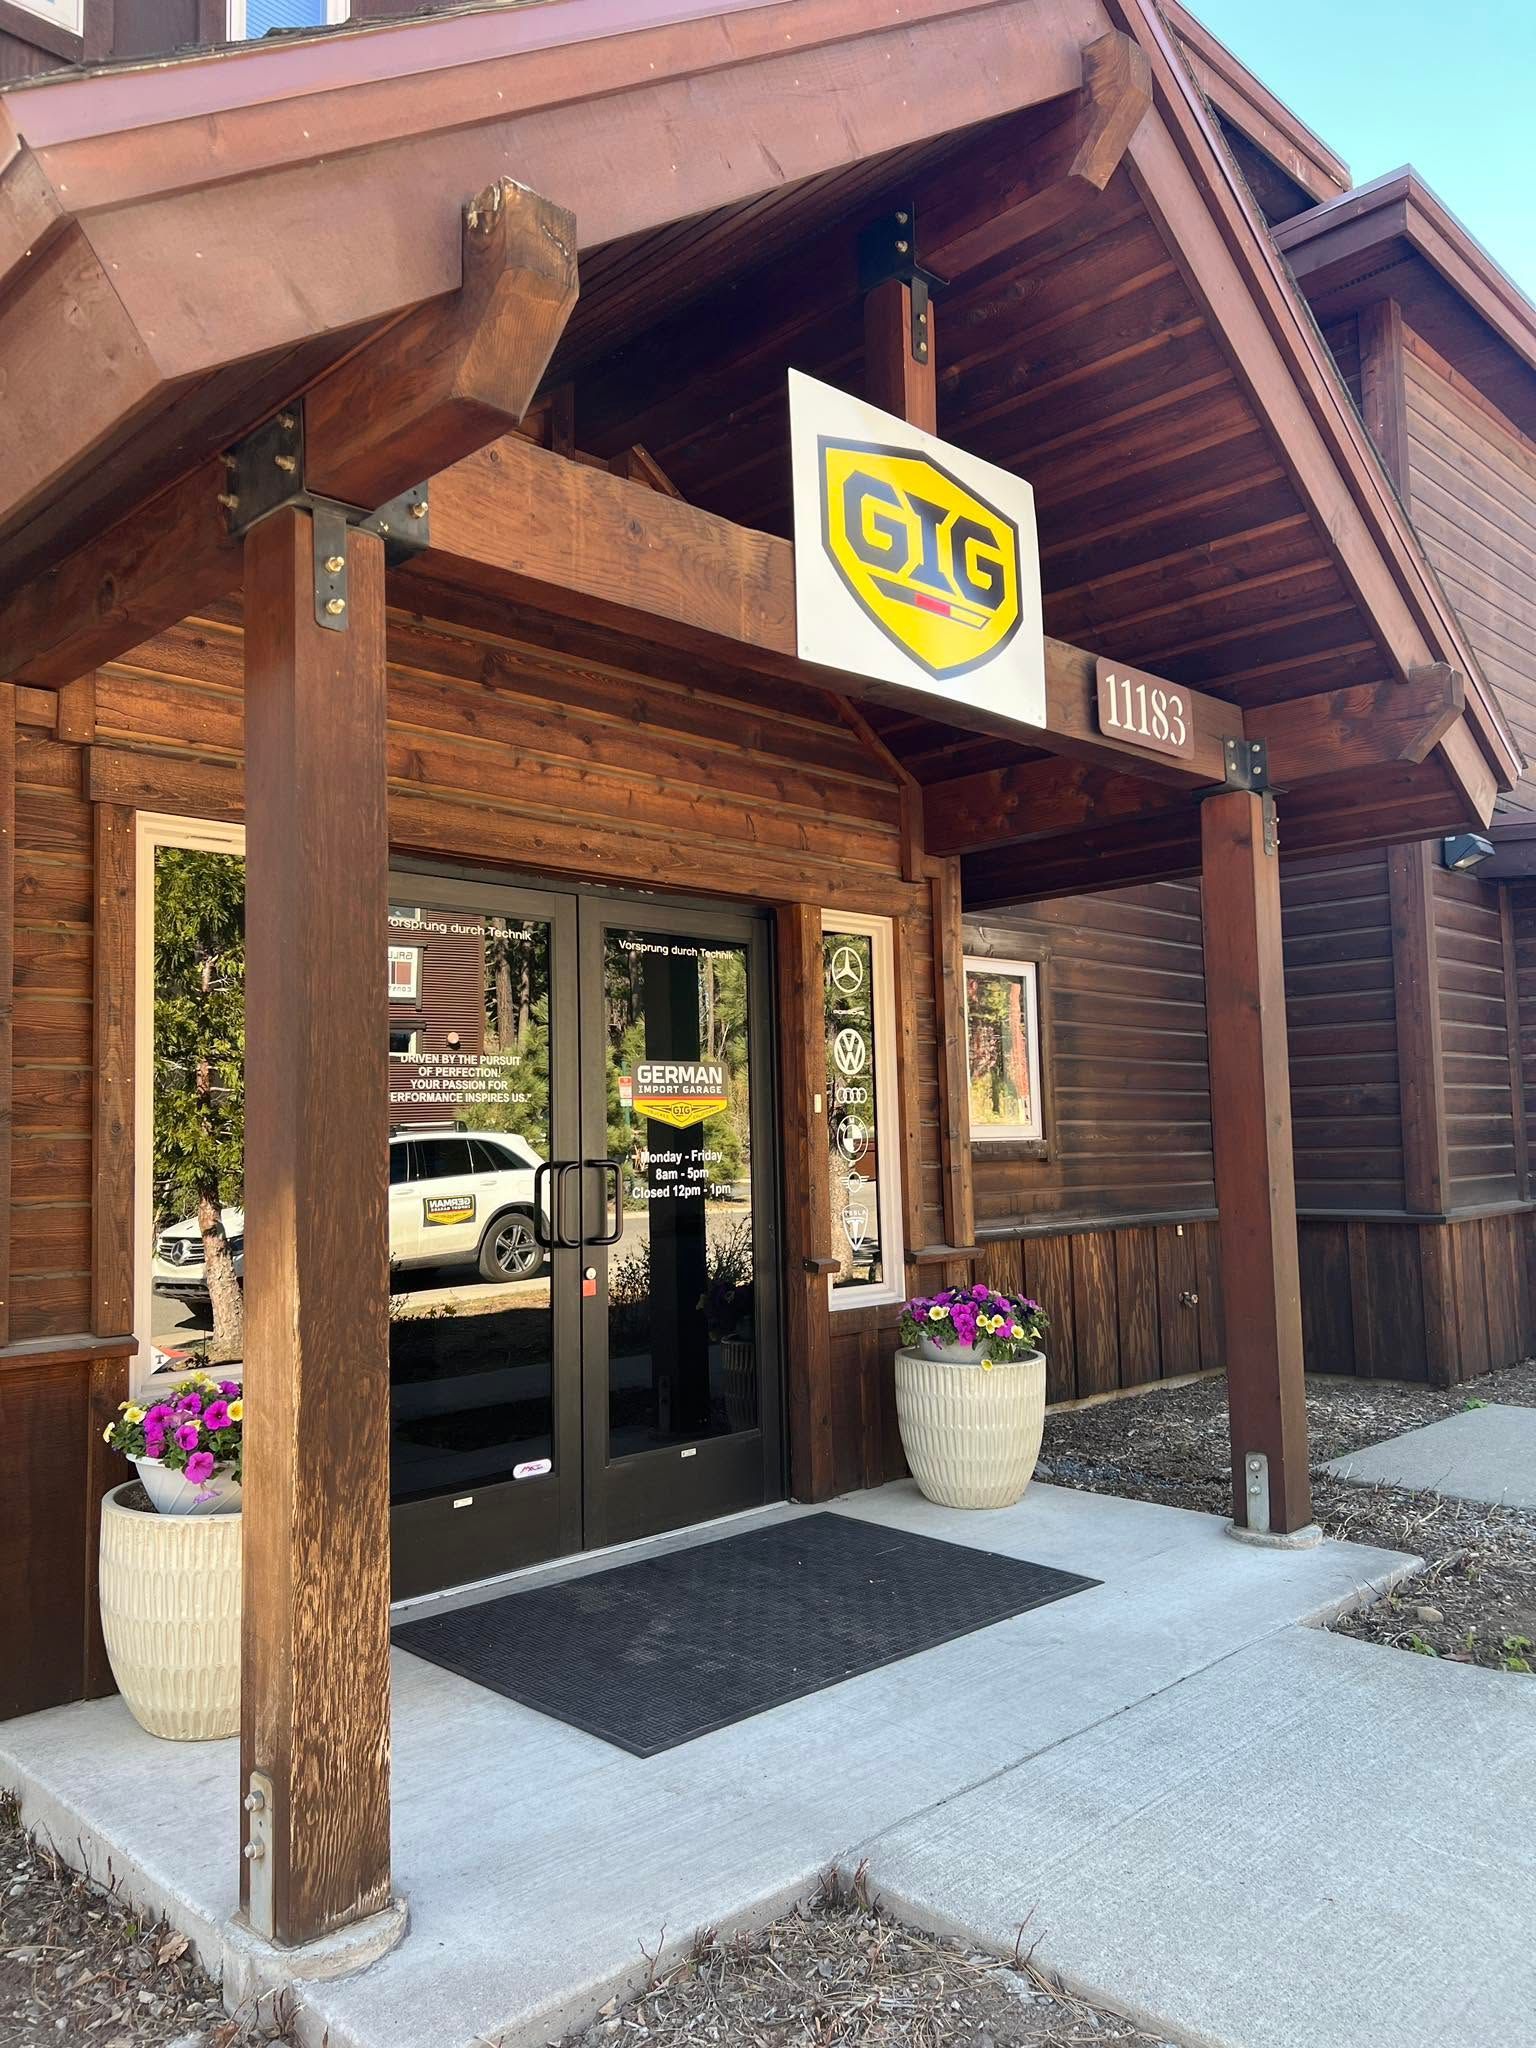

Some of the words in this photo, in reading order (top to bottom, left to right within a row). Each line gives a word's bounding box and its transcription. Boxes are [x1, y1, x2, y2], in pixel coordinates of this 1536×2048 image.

[843, 470, 1005, 611] GIG
[1106, 674, 1186, 746] 11183
[388, 916, 447, 934] orsprung
[450, 924, 485, 936] durch
[488, 927, 532, 940] Technik
[618, 940, 669, 955] Vorsprung
[671, 946, 698, 957] durch
[700, 949, 734, 960] Technik
[400, 1054, 440, 1064] DRIVEN
[442, 1055, 456, 1064] BY
[459, 1055, 478, 1065] THE
[480, 1056, 521, 1066] PURSUIT
[418, 1067, 434, 1077] OF
[637, 1065, 722, 1084] GERMAN
[411, 1080, 441, 1090] YOUR
[442, 1080, 485, 1090] PASSION
[488, 1081, 508, 1090] FOR
[638, 1085, 678, 1094] IMPORT
[682, 1085, 722, 1094] GARAGE
[390, 1092, 463, 1102] ERFORMANCE
[465, 1093, 509, 1103] INSPIRES
[673, 1106, 690, 1115] GIG
[641, 1151, 682, 1165] Monday
[691, 1149, 722, 1163] Friday
[655, 1168, 678, 1180] 8am
[687, 1167, 709, 1181] 5pm
[632, 1185, 670, 1198] Closed
[672, 1184, 701, 1199] 12pm
[710, 1183, 731, 1197] 1pm
